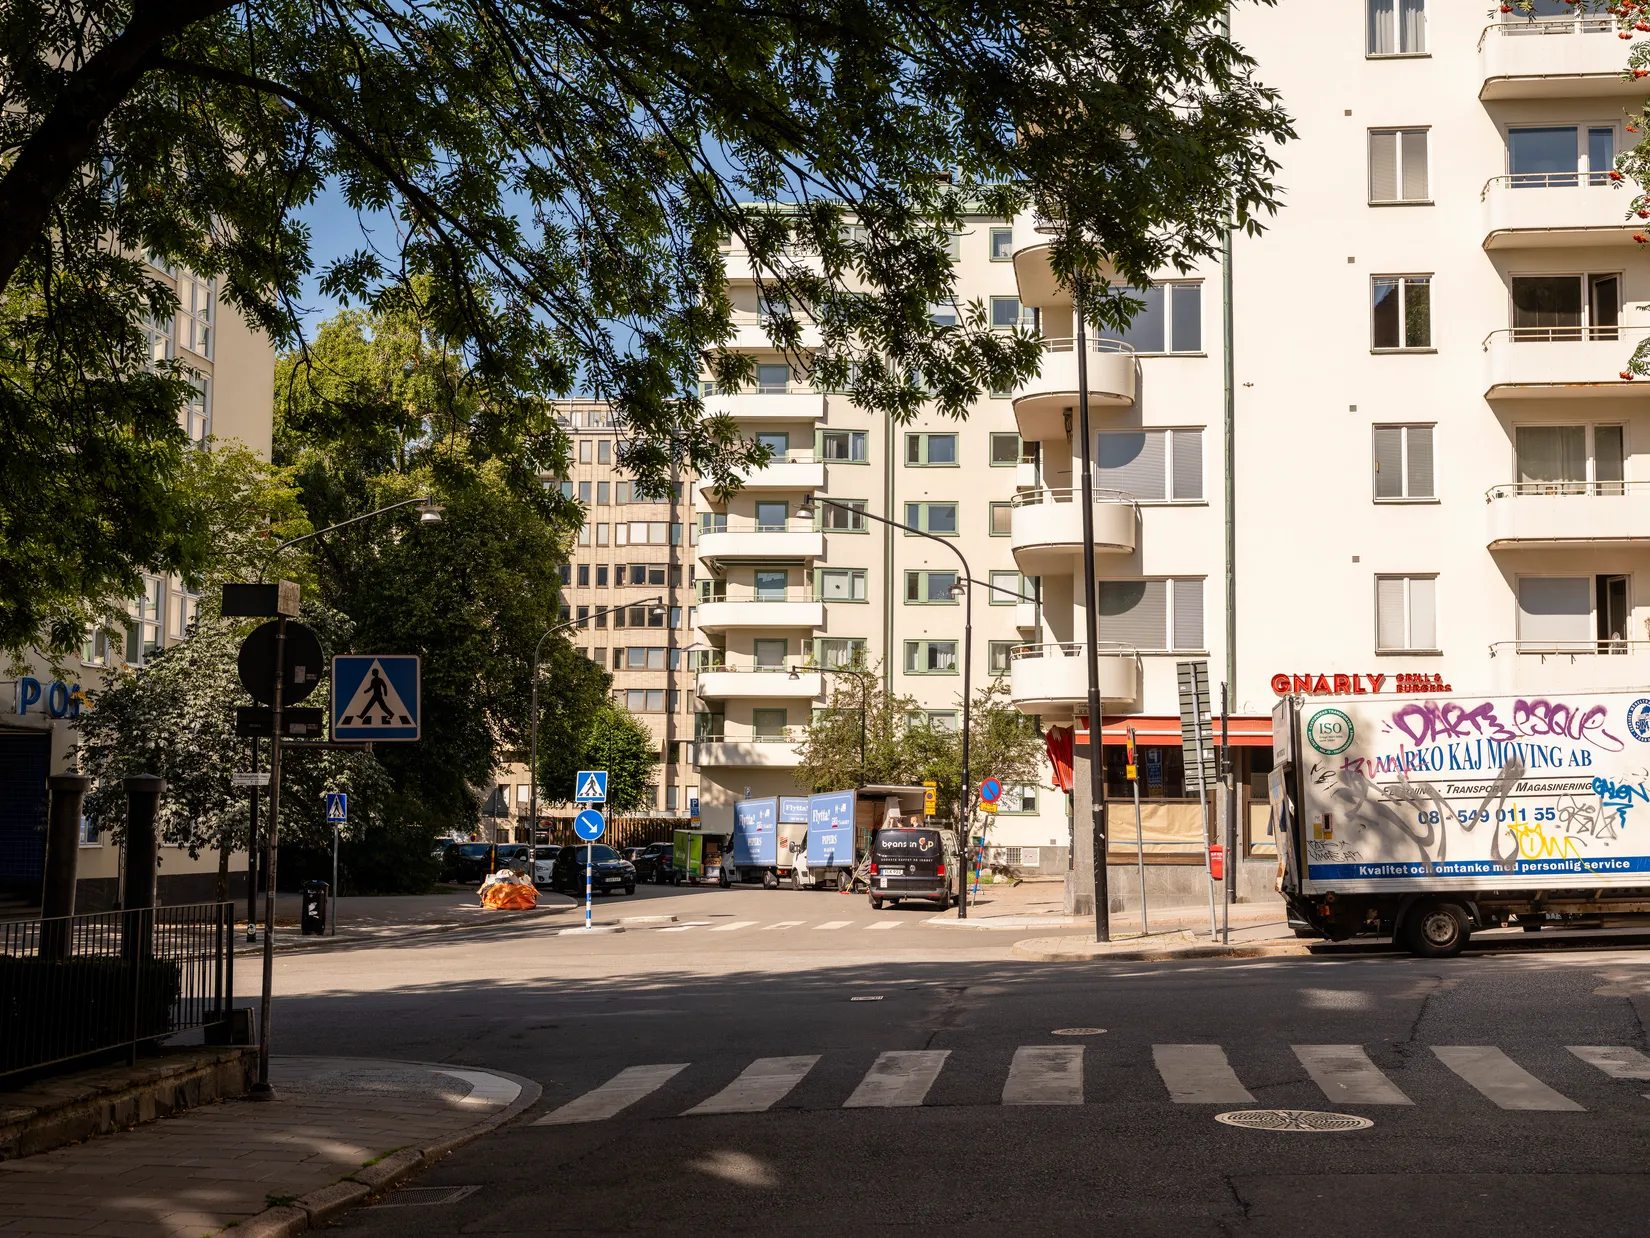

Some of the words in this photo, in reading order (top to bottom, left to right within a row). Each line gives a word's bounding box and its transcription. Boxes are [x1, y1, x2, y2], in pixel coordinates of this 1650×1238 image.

[1271, 673, 1385, 694] GNARLY
[1396, 673, 1431, 682] GRILL
[1396, 684, 1452, 693] BURGERS
[1319, 722, 1342, 734] ISO
[1376, 745, 1444, 772] MARKO
[1448, 739, 1481, 770] KAJ
[1486, 738, 1562, 769] MOVING
[1568, 749, 1592, 767] AB
[1515, 782, 1592, 792] MAGASINERING
[1418, 810, 1440, 825] 08
[1457, 809, 1490, 823] 549
[1495, 808, 1526, 822] 011
[1534, 807, 1556, 821] 55
[882, 840, 907, 849] beans
[1359, 865, 1408, 876] Kvalitet
[1435, 863, 1490, 873] omtanke
[1492, 862, 1518, 871] med
[1522, 860, 1581, 872] personlig
[1583, 859, 1630, 870] service
